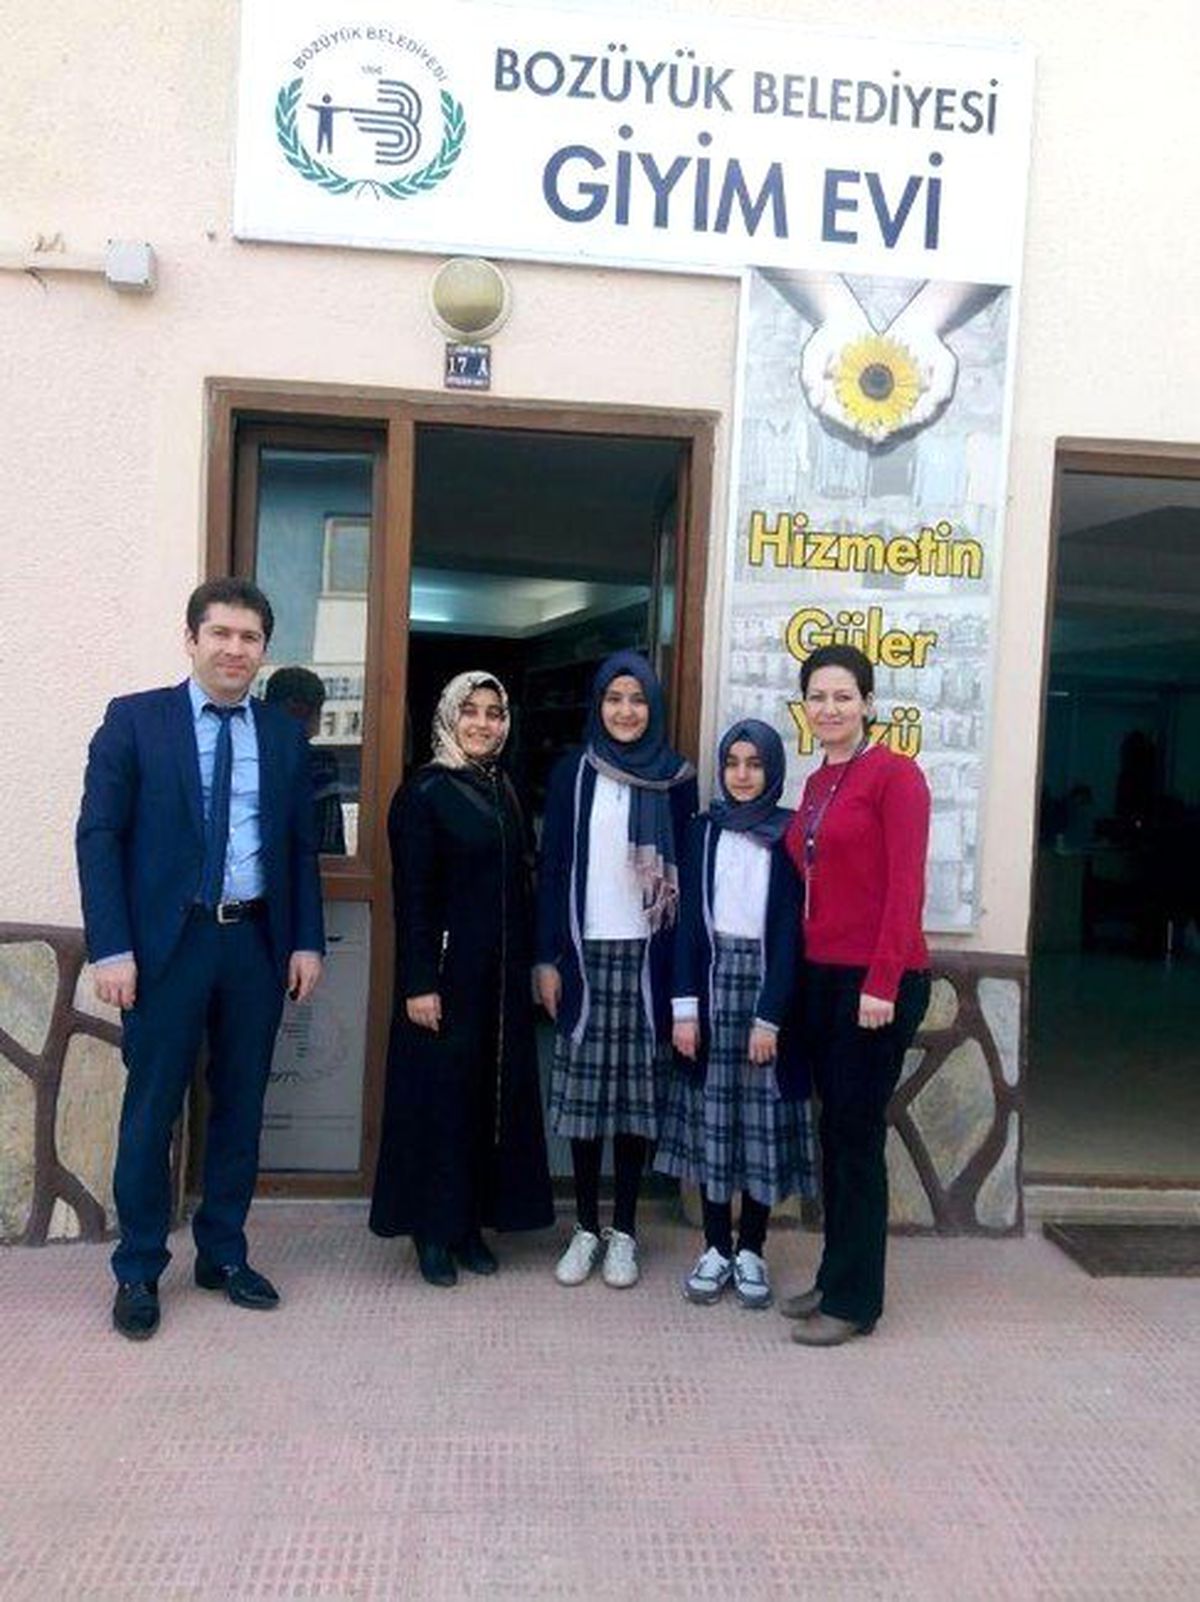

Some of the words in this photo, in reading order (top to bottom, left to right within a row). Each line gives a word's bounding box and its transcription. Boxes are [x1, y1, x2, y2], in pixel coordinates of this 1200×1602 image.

[494, 42, 734, 112] BOZÜYÜK
[752, 69, 998, 135] BELEDİYESİ
[542, 124, 789, 238] GİYİM
[821, 151, 943, 250] EVİ
[749, 511, 984, 579] Hizmetin
[785, 606, 937, 668] Güler
[787, 701, 922, 760] Yzü
